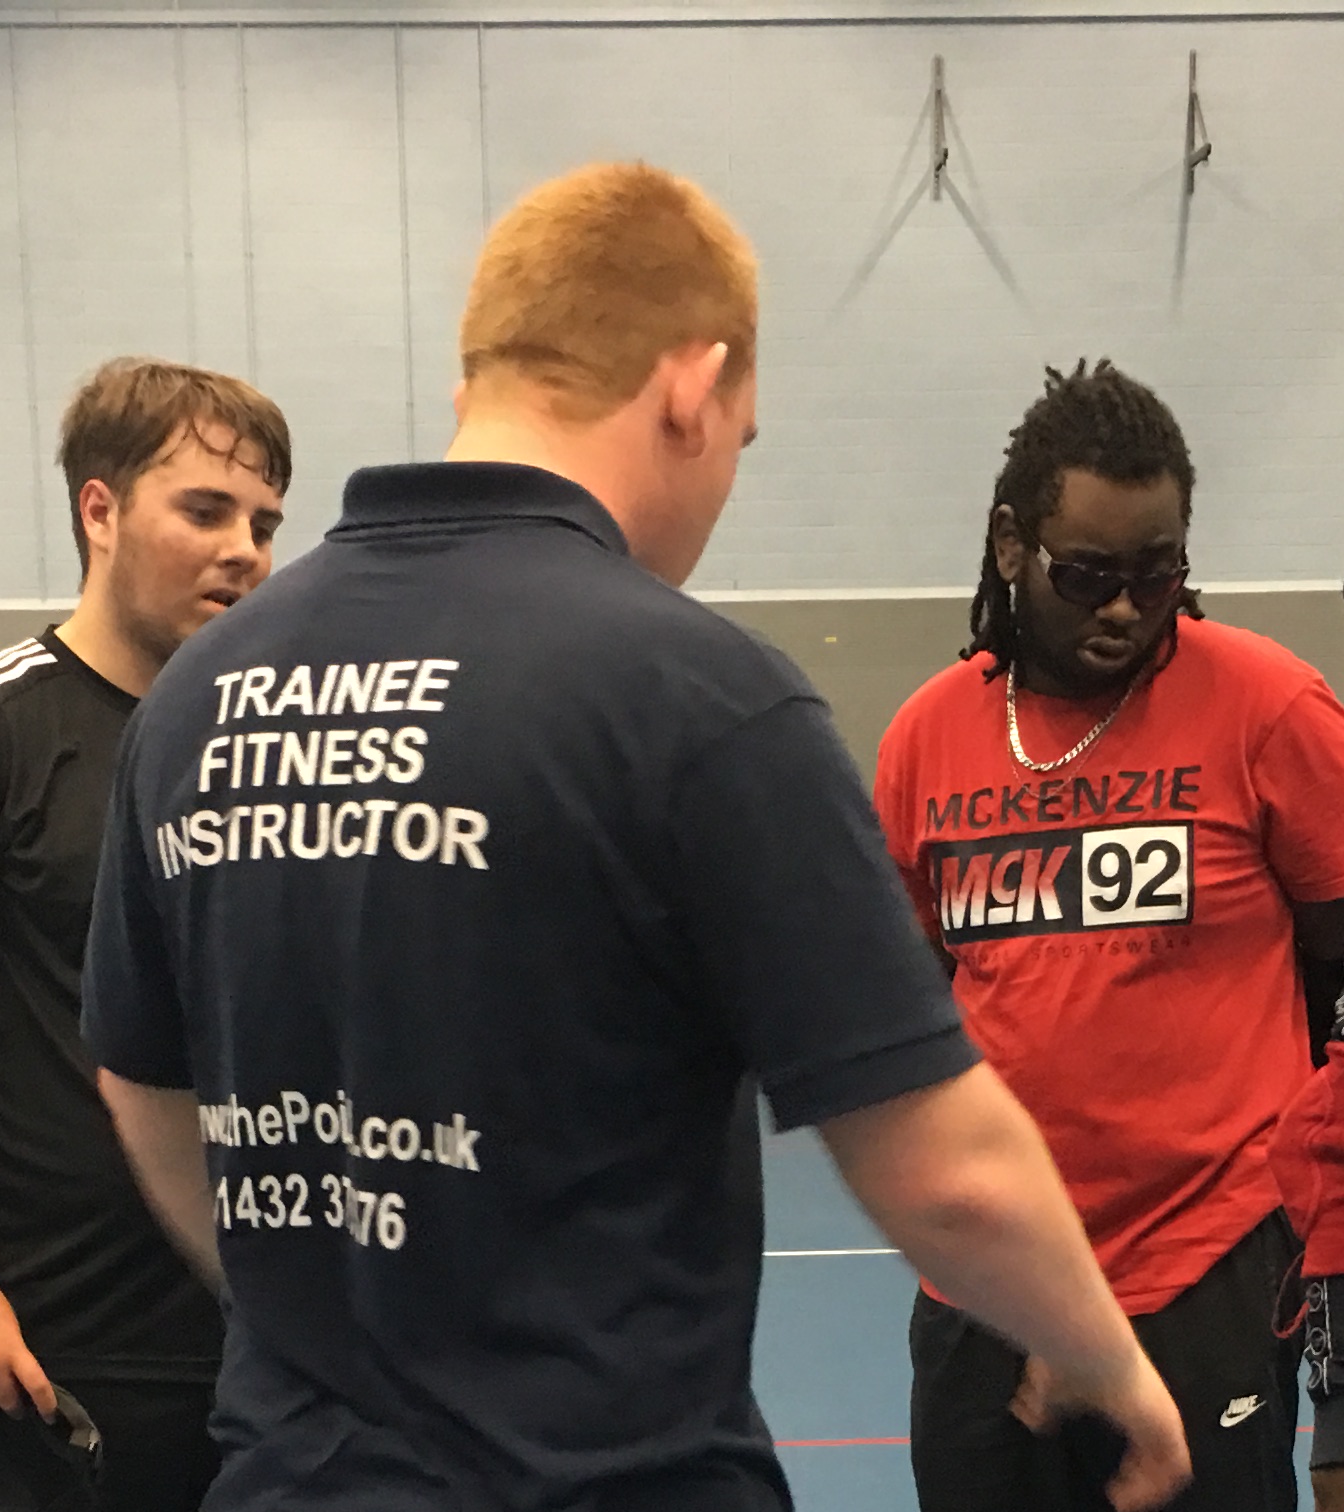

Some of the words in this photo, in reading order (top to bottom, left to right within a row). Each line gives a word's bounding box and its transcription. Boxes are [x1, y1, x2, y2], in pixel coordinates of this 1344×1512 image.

[214, 659, 459, 724] TRAINEE
[197, 726, 429, 793] FITNESS
[925, 765, 1202, 833] MCKENZIE
[156, 800, 490, 879] INSTRUCTOR
[1087, 839, 1183, 912] 92
[213, 1173, 312, 1230] 1432
